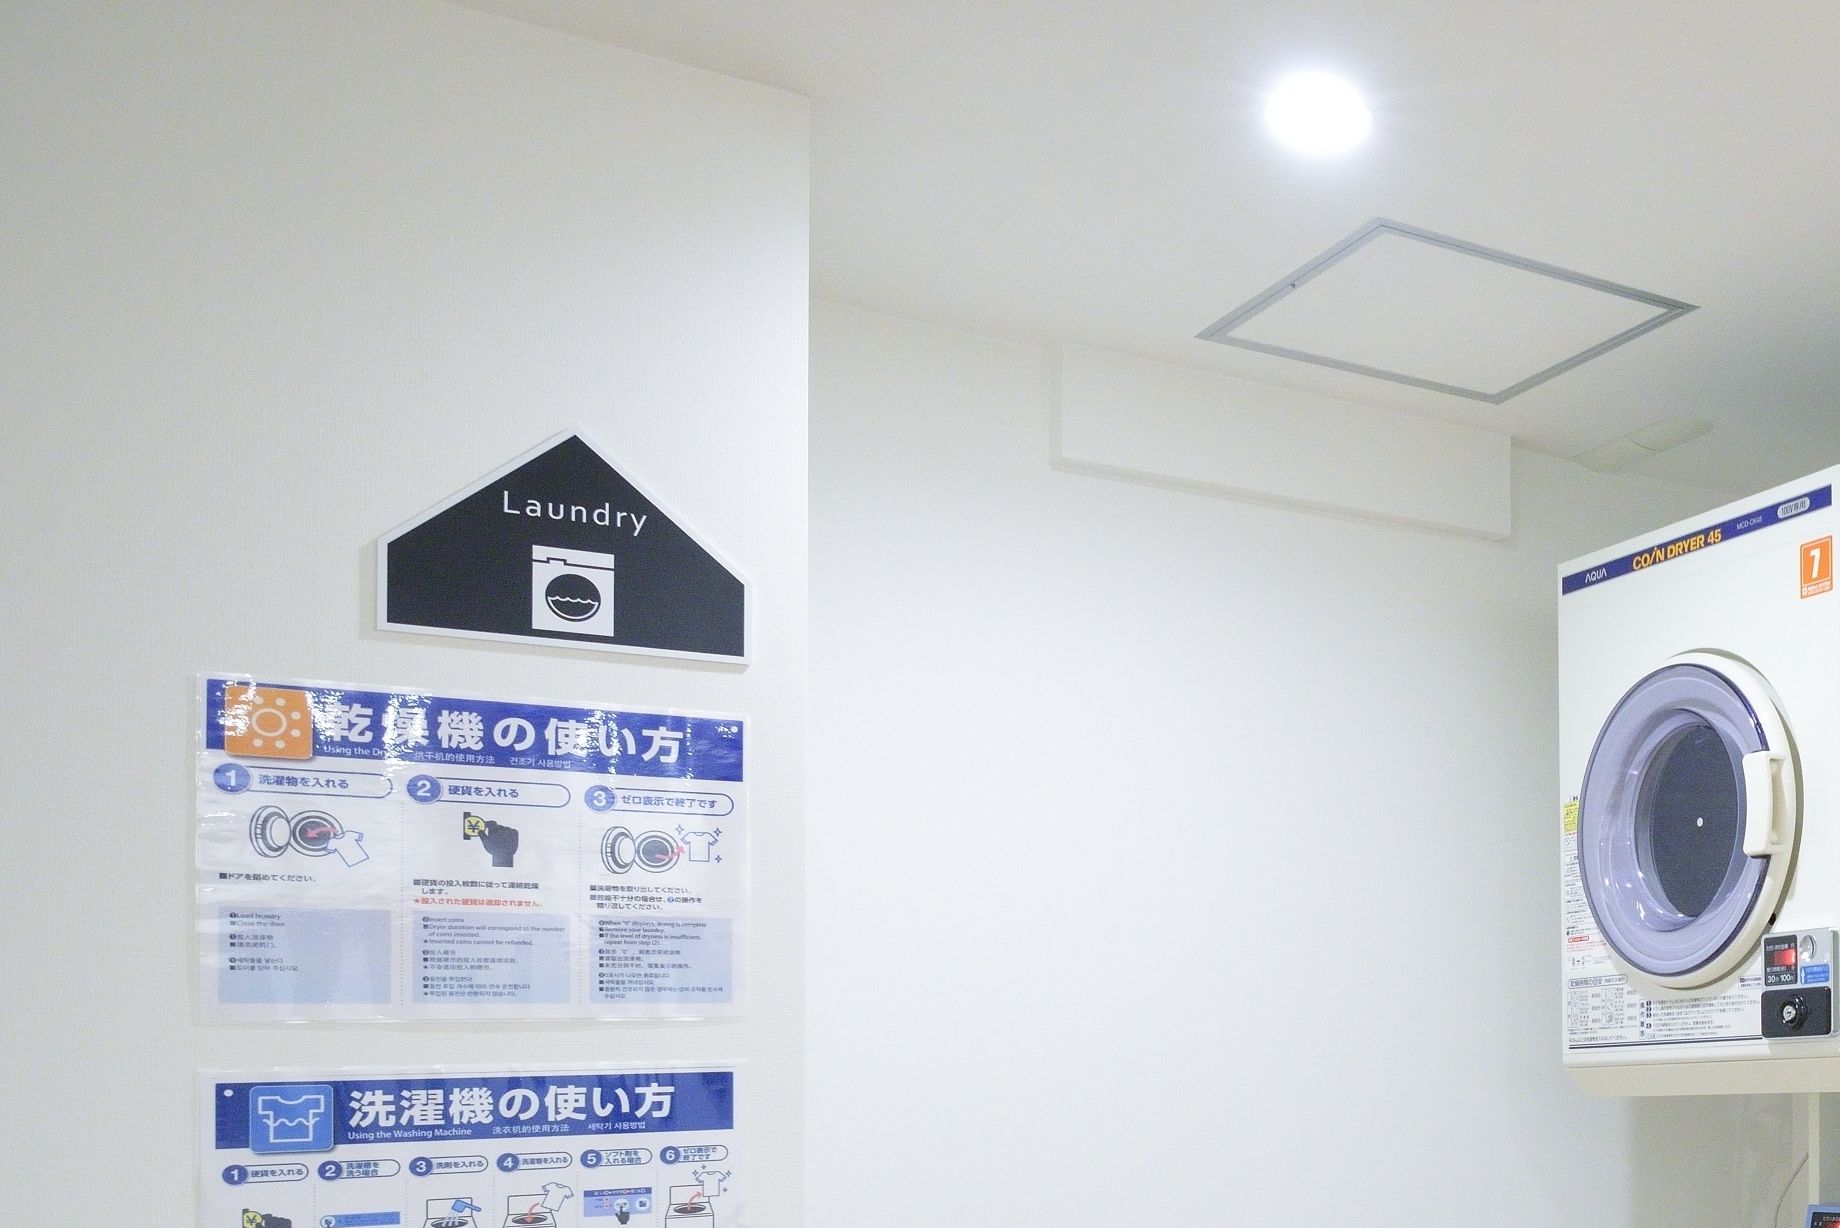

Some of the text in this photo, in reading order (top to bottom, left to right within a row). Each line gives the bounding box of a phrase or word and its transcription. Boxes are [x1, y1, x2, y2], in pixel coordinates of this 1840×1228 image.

[503, 490, 648, 537] Laundry
[1632, 528, 1722, 571] COIN DRYER 45
[1809, 547, 1821, 580] 7
[1585, 567, 1608, 584] AQUA
[324, 745, 352, 756] Using
[225, 769, 349, 789] 1 洗濯物を入れる
[416, 781, 519, 798] 2 硬貨を入れる
[593, 790, 717, 809] 3 ゼロ表示で終了です
[350, 1082, 676, 1128] 洗濯機の使い方
[348, 1127, 472, 1140] Using the Washing Machine
[502, 1156, 514, 1169] 4
[586, 1153, 597, 1164] 5
[665, 1149, 675, 1161] 6
[324, 1165, 336, 1177] 2
[415, 1160, 485, 1173] 3 洗剤を入れる
[230, 1168, 304, 1181] 1 硬貨を入れる
